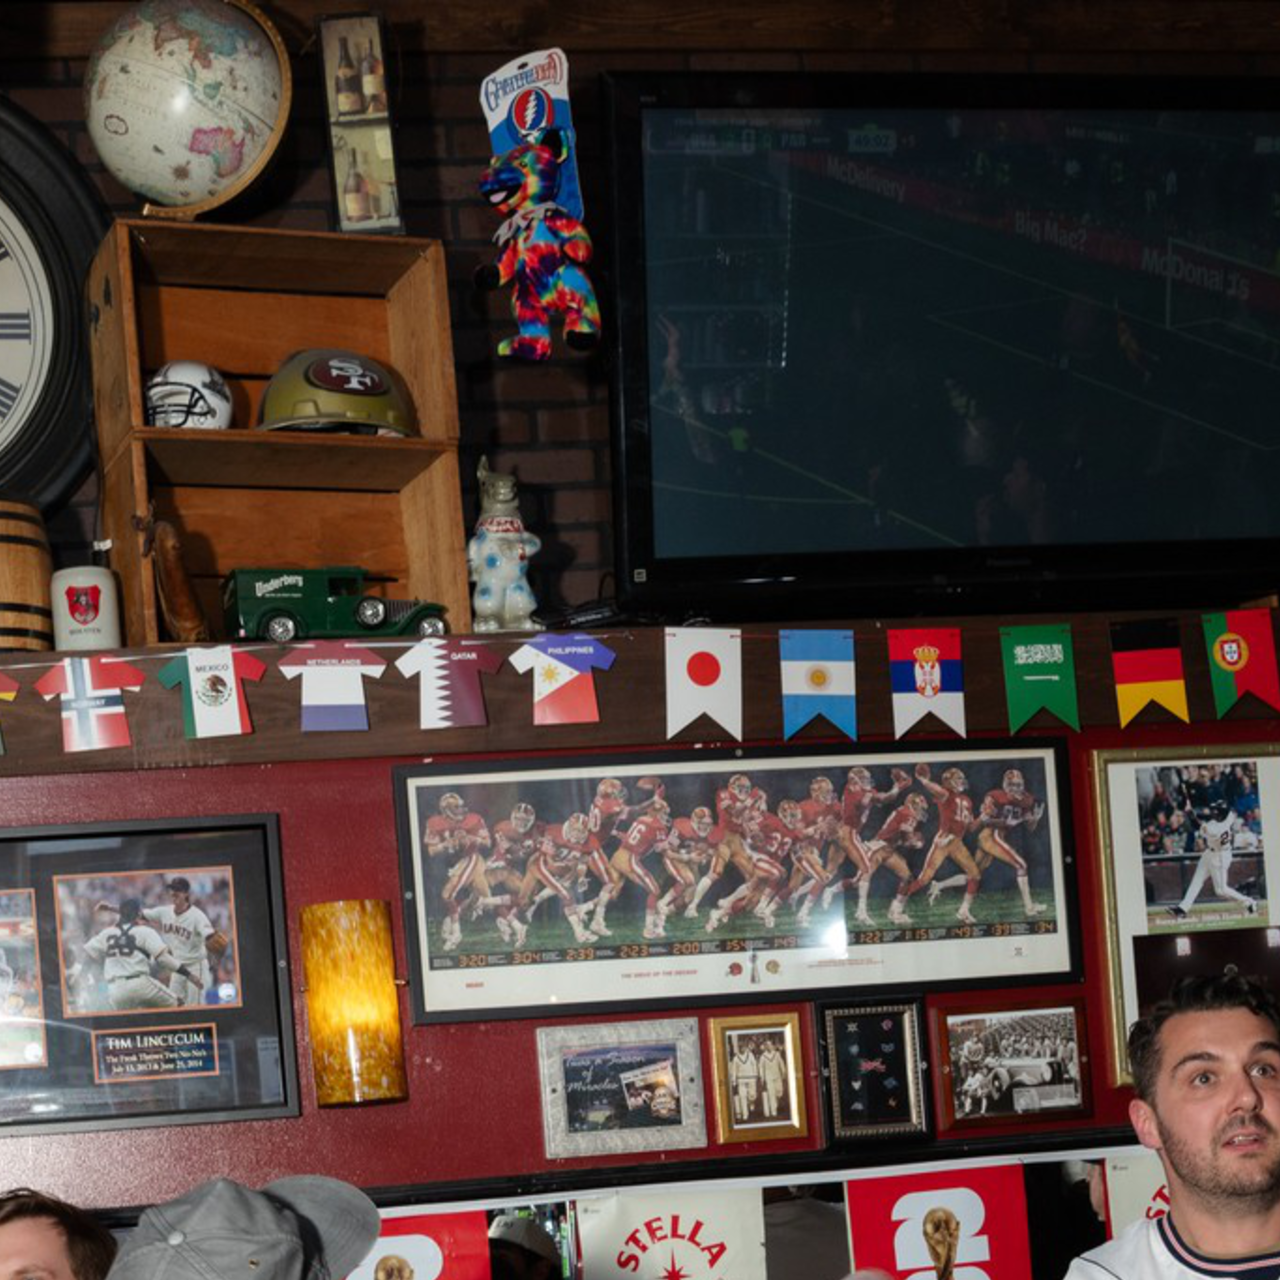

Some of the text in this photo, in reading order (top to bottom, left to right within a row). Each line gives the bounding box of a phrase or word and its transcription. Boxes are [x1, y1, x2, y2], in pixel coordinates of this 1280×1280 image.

[255, 572, 304, 597] Underberg
[450, 651, 478, 661] QATAR
[547, 645, 595, 657] PHILIPPINES
[305, 657, 362, 667] NETHERLANDS
[194, 663, 230, 674] MEXICO
[106, 1033, 205, 1050] TIM LINCECUM
[616, 1214, 727, 1272] STELLA
